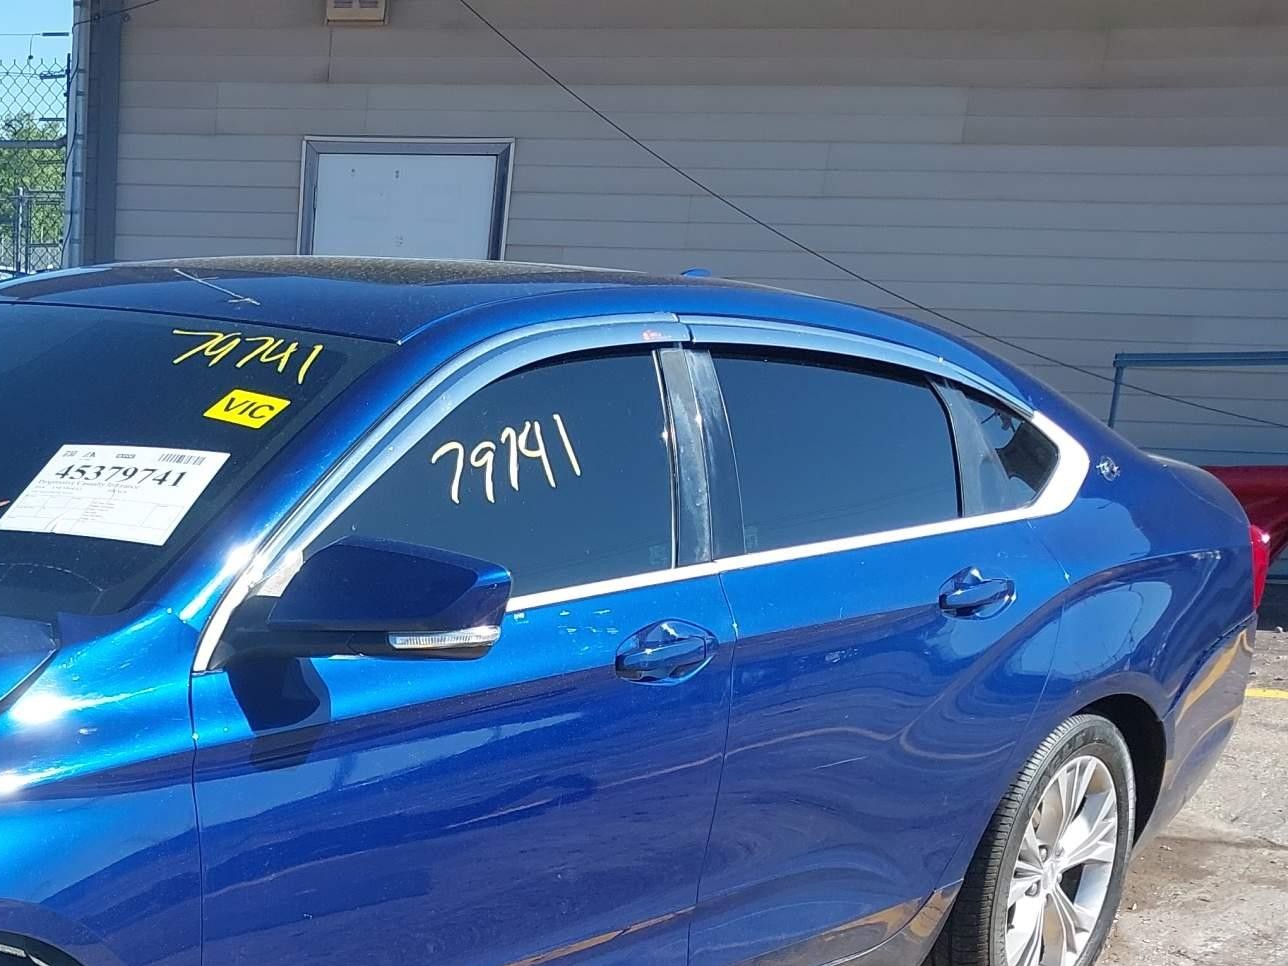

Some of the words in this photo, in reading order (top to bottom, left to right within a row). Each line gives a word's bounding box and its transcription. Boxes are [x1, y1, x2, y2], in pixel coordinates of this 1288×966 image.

[172, 328, 324, 384] 79741
[221, 396, 278, 421] VIC
[54, 464, 188, 488] 45379741
[431, 413, 582, 505] 79741
